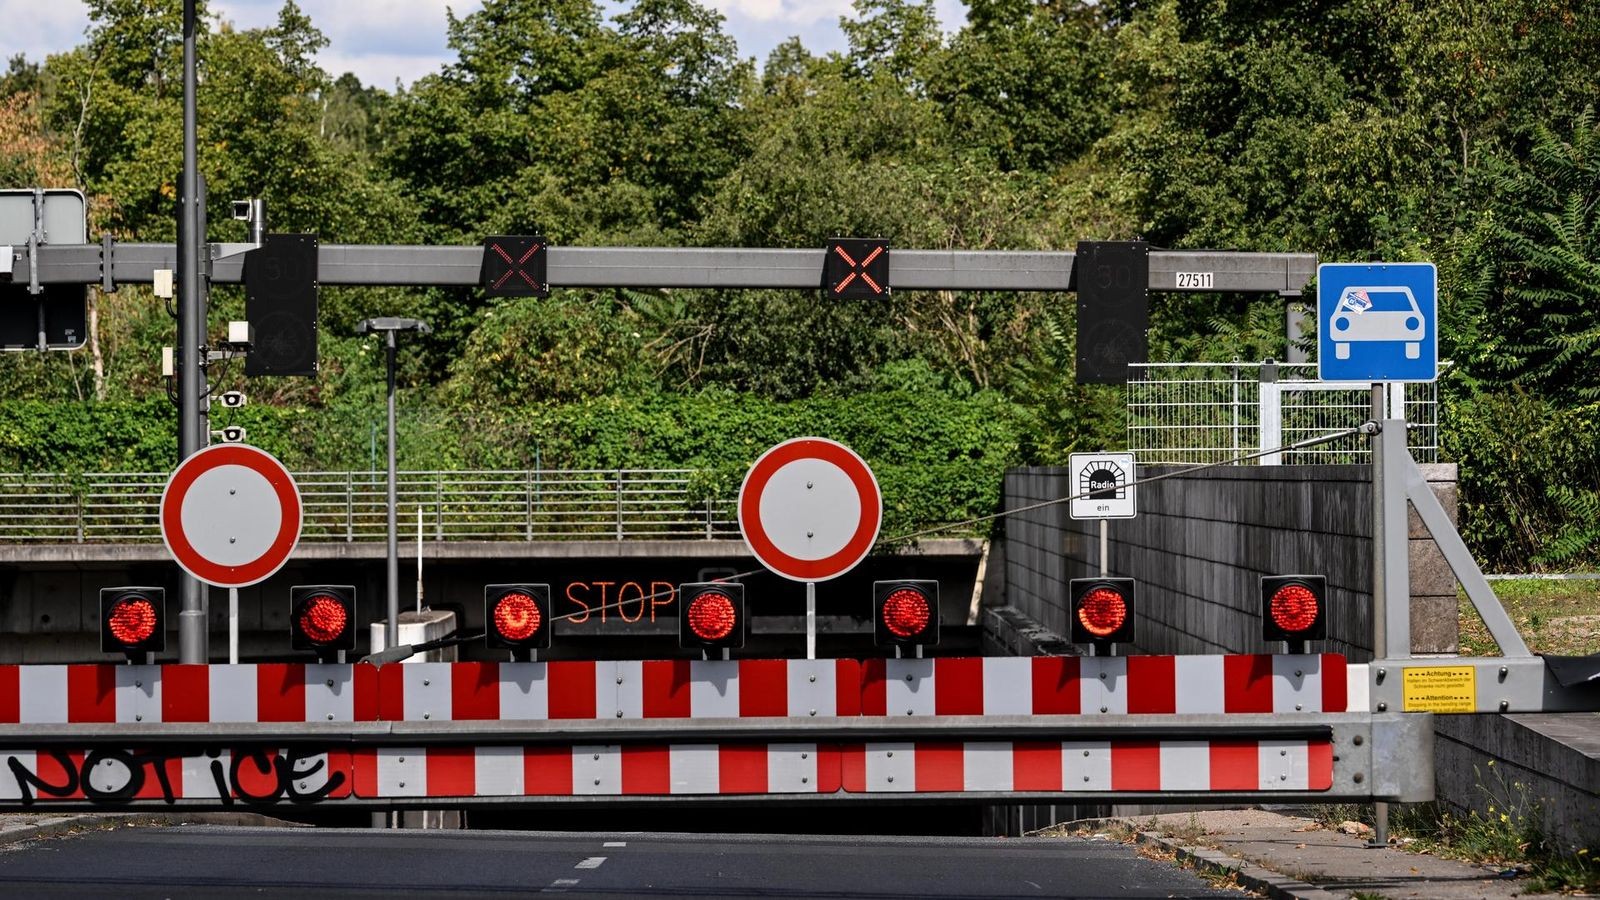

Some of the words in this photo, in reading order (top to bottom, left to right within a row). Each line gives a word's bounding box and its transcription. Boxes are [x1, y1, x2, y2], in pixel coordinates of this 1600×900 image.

[1178, 273, 1211, 288] 27511
[1090, 480, 1115, 489] Radio
[1096, 503, 1110, 512] ein
[565, 581, 675, 624] STOP
